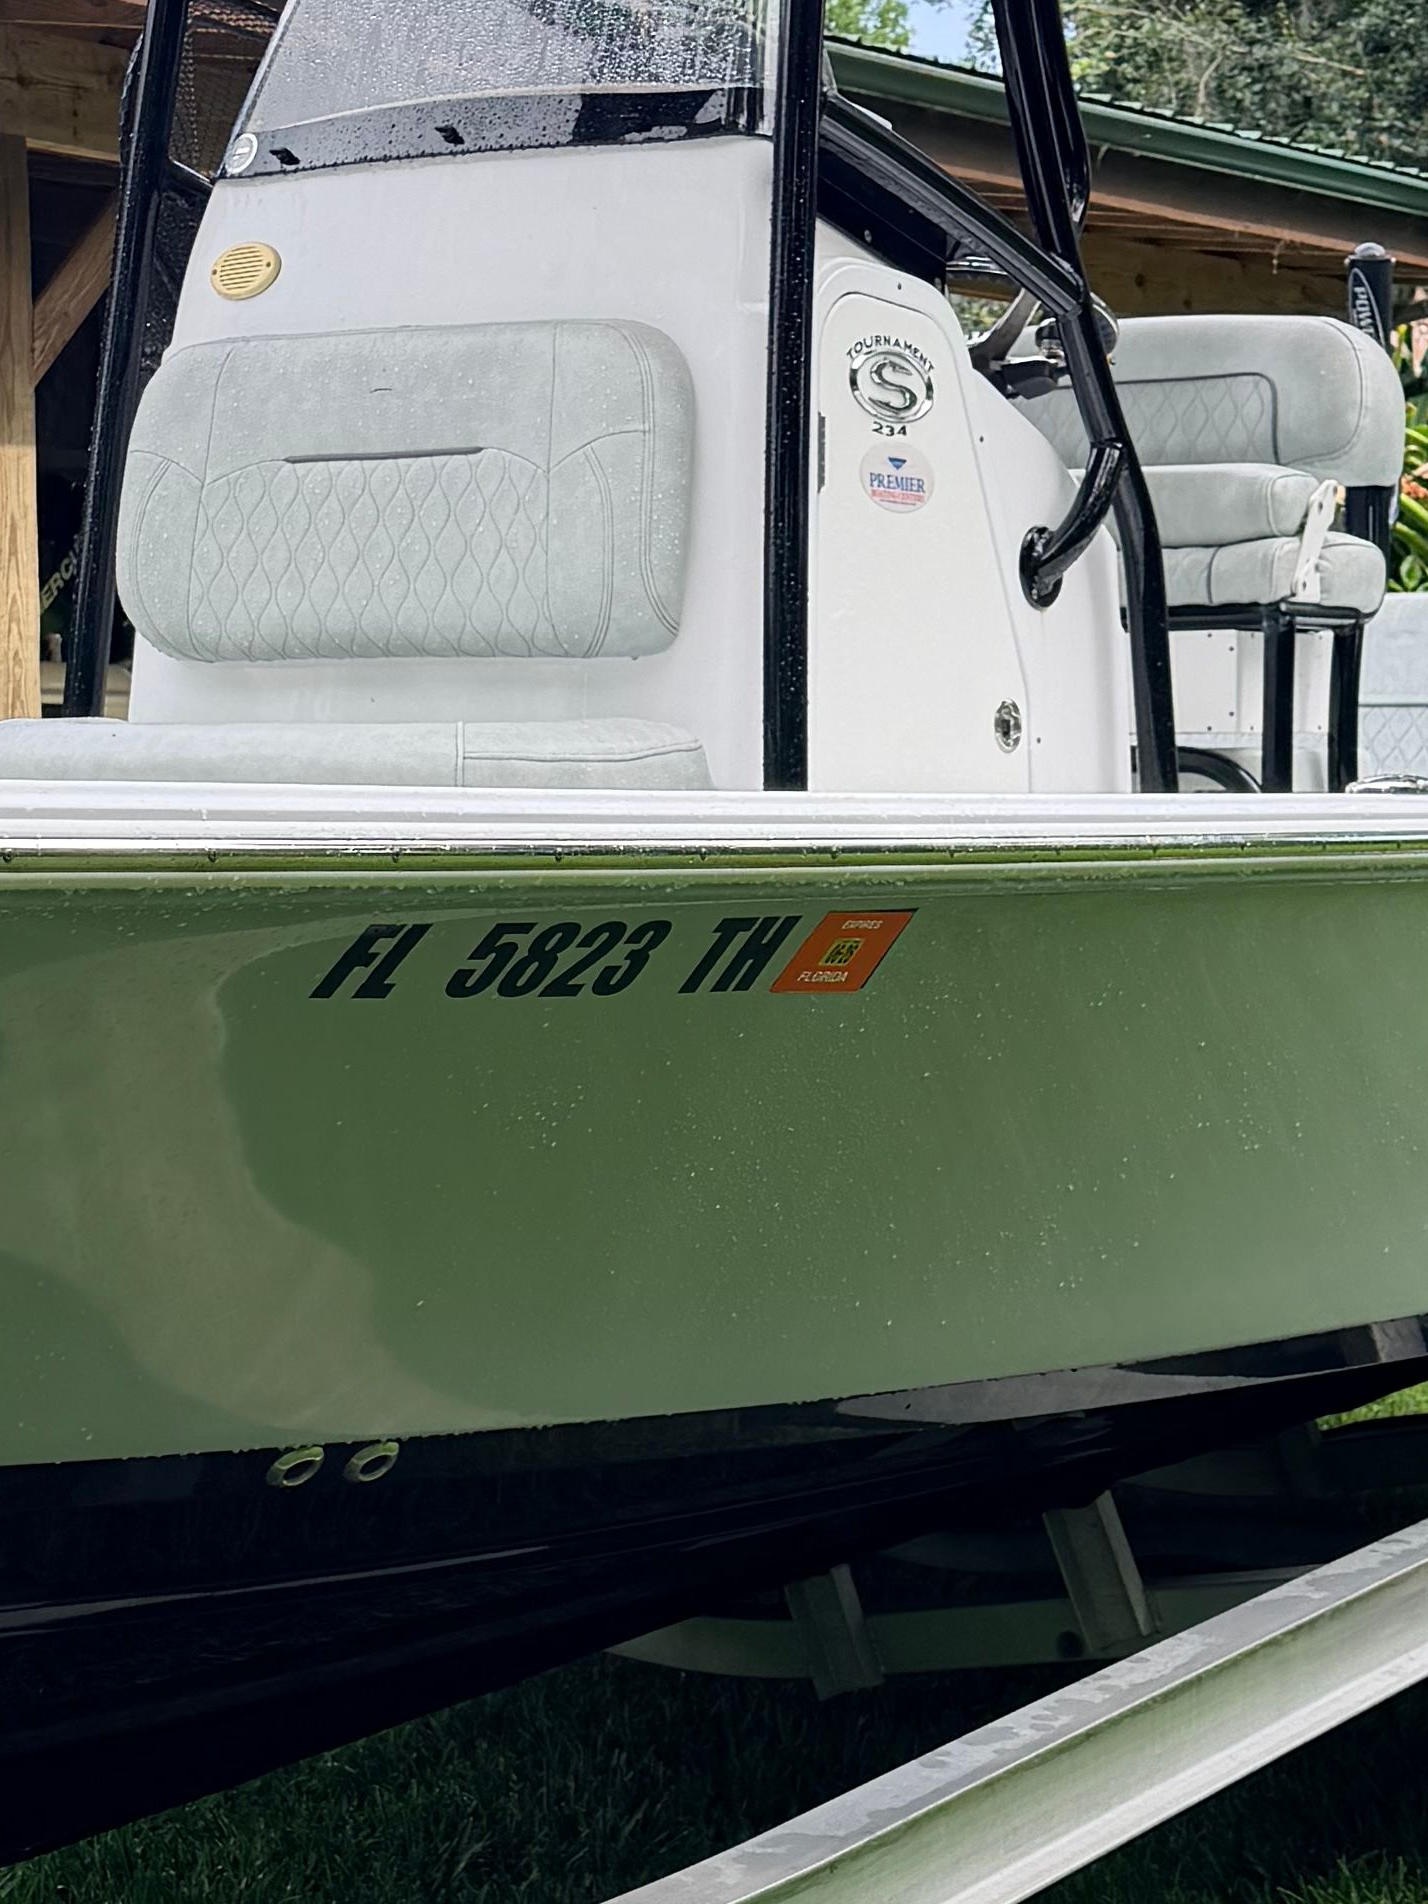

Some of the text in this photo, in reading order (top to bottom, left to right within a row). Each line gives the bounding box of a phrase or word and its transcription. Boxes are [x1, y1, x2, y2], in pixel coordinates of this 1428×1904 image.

[846, 335, 935, 372] TOURNAMENT
[872, 421, 908, 436] 234
[869, 472, 926, 493] PREMIER
[40, 549, 77, 615] ERC
[309, 915, 803, 999] FL 5823 TH
[796, 971, 849, 983] FLORIDA
